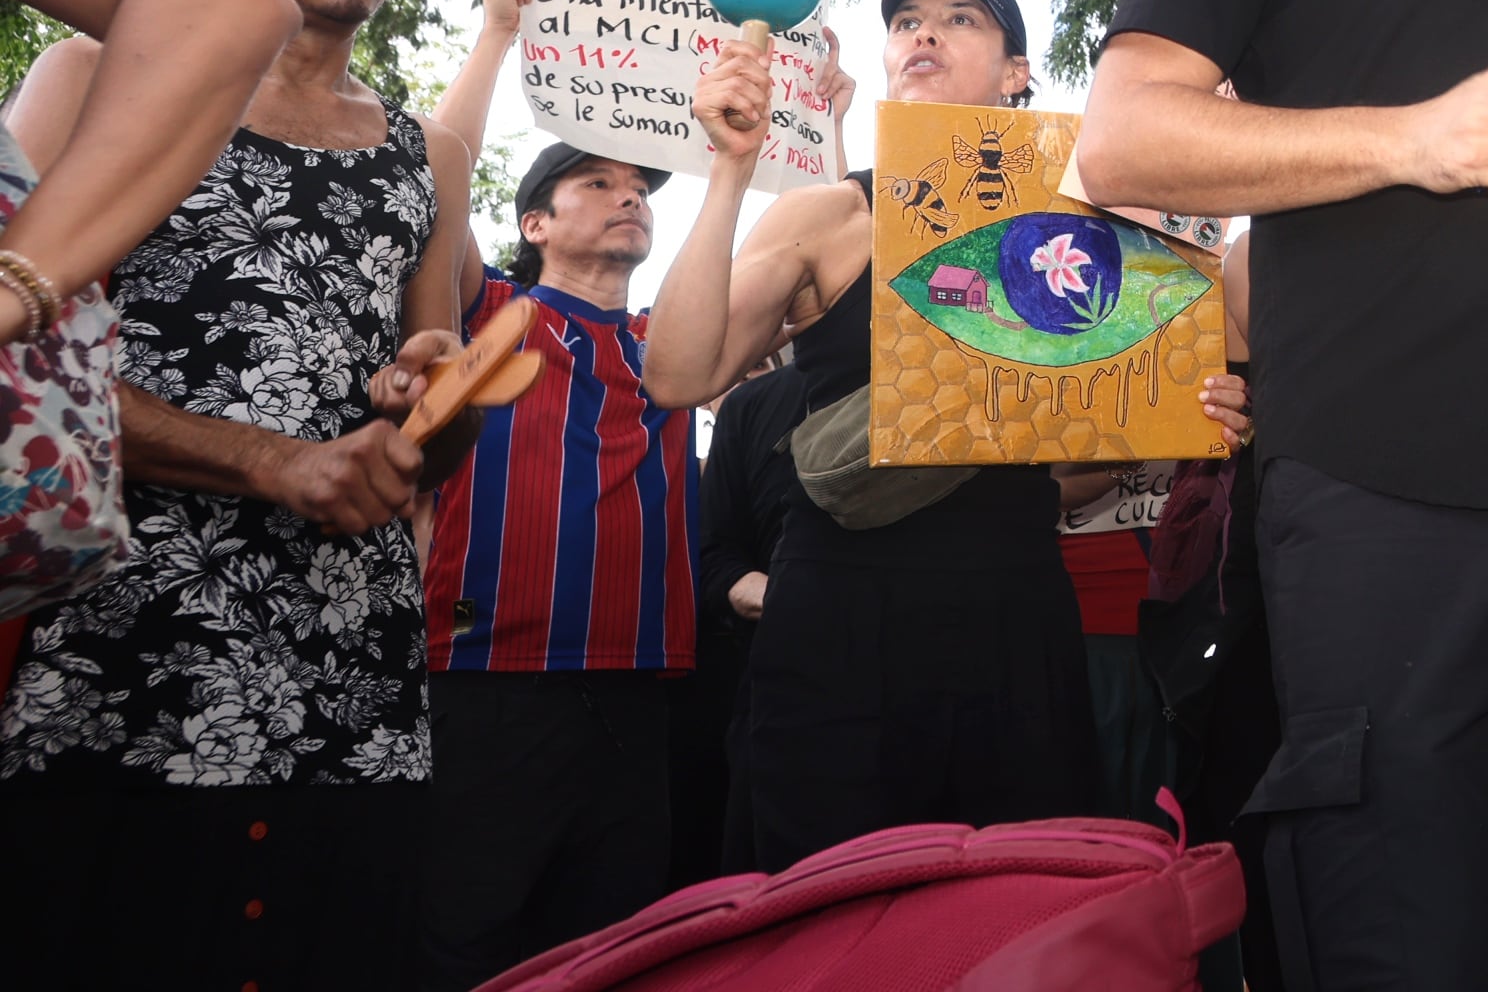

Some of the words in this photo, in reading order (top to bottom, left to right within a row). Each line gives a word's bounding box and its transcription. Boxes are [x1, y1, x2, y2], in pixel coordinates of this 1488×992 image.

[539, 11, 570, 36] al
[524, 38, 561, 62] Un
[569, 42, 638, 69] 11%
[525, 65, 561, 89] de
[570, 75, 604, 96] su
[798, 122, 824, 145] año
[530, 95, 559, 117] se
[576, 98, 594, 122] le
[609, 107, 690, 140] suman
[1115, 498, 1165, 525] CUL
